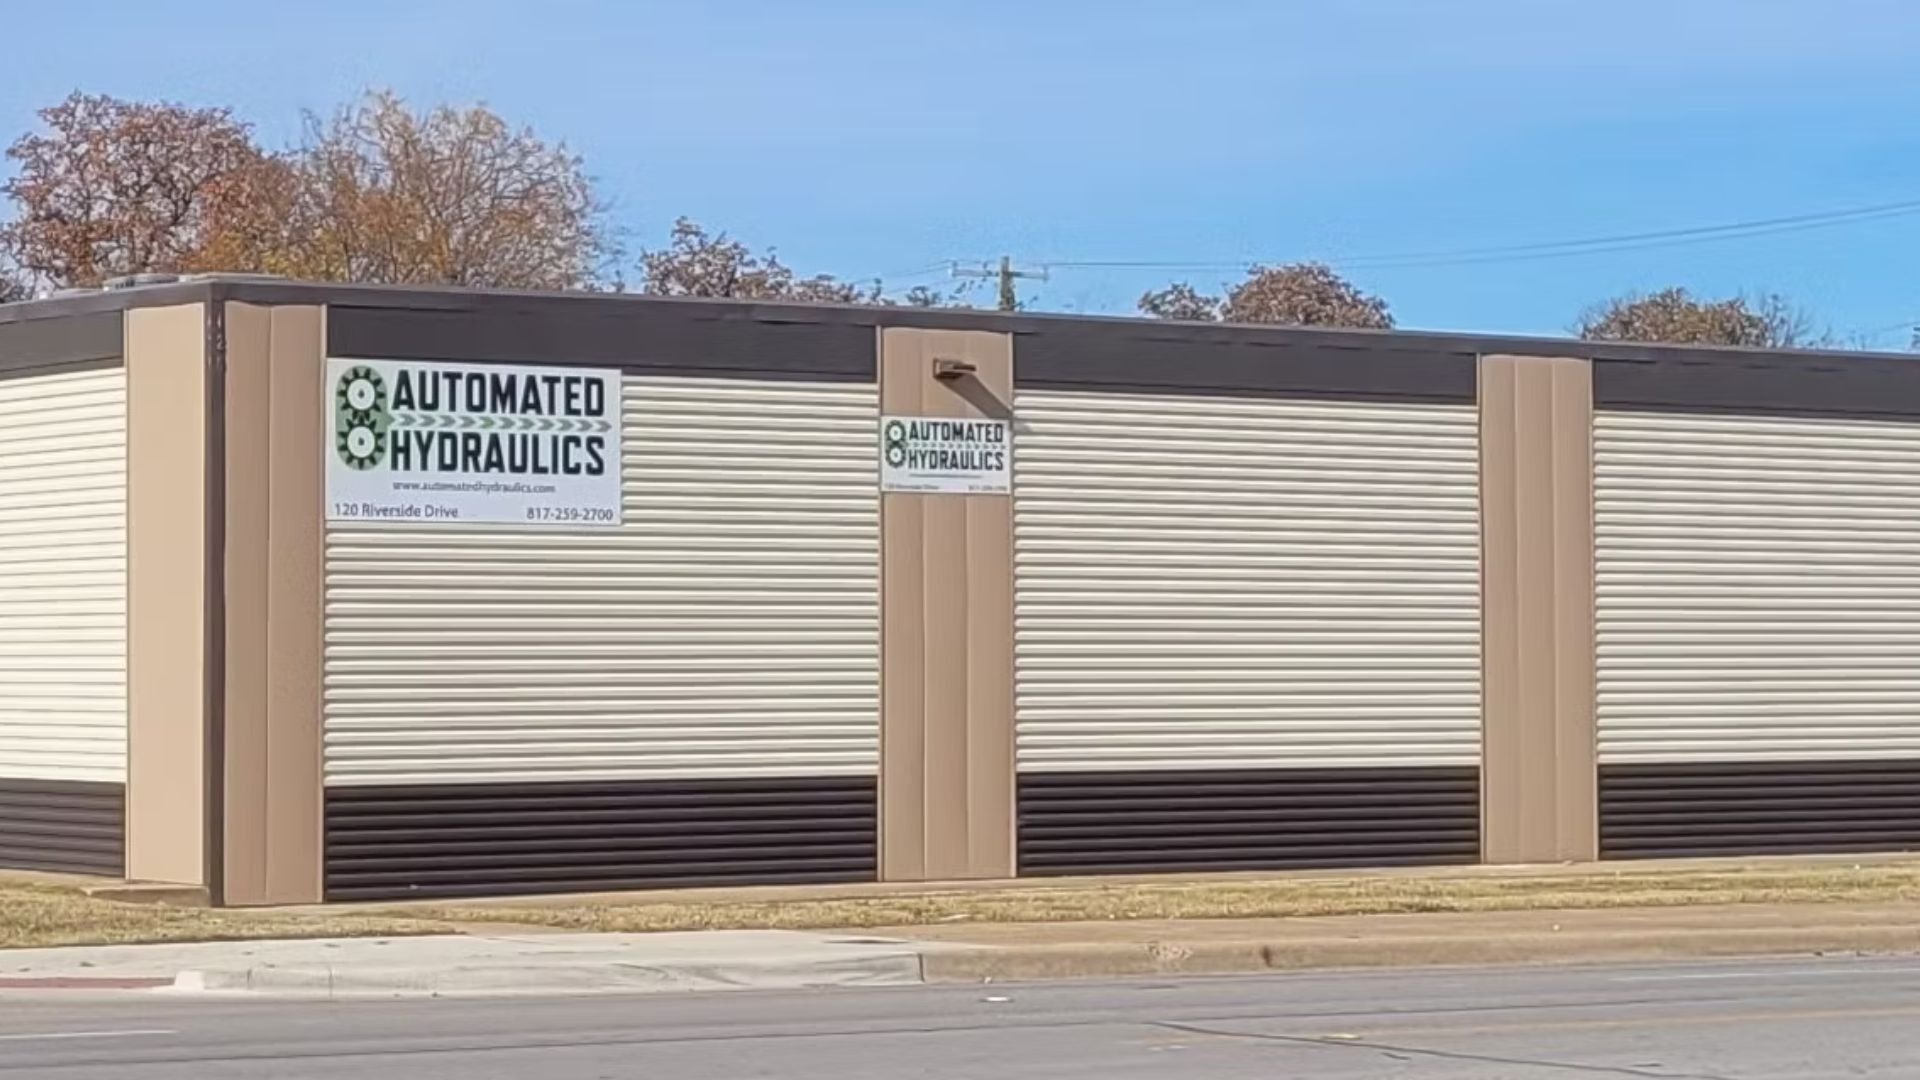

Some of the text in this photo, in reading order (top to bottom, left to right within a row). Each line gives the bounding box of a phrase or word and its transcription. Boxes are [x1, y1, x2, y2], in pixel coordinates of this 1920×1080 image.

[391, 369, 605, 417] AUTOMATED
[909, 421, 1003, 442] AUTOMATED
[390, 430, 606, 475] HYDRAULICS
[908, 450, 1004, 470] HYDRAULICS
[392, 481, 556, 494] www.automatedhydraulics.com
[335, 503, 459, 518] 120 Riverside Drive
[526, 507, 614, 521] 817-259-2700
